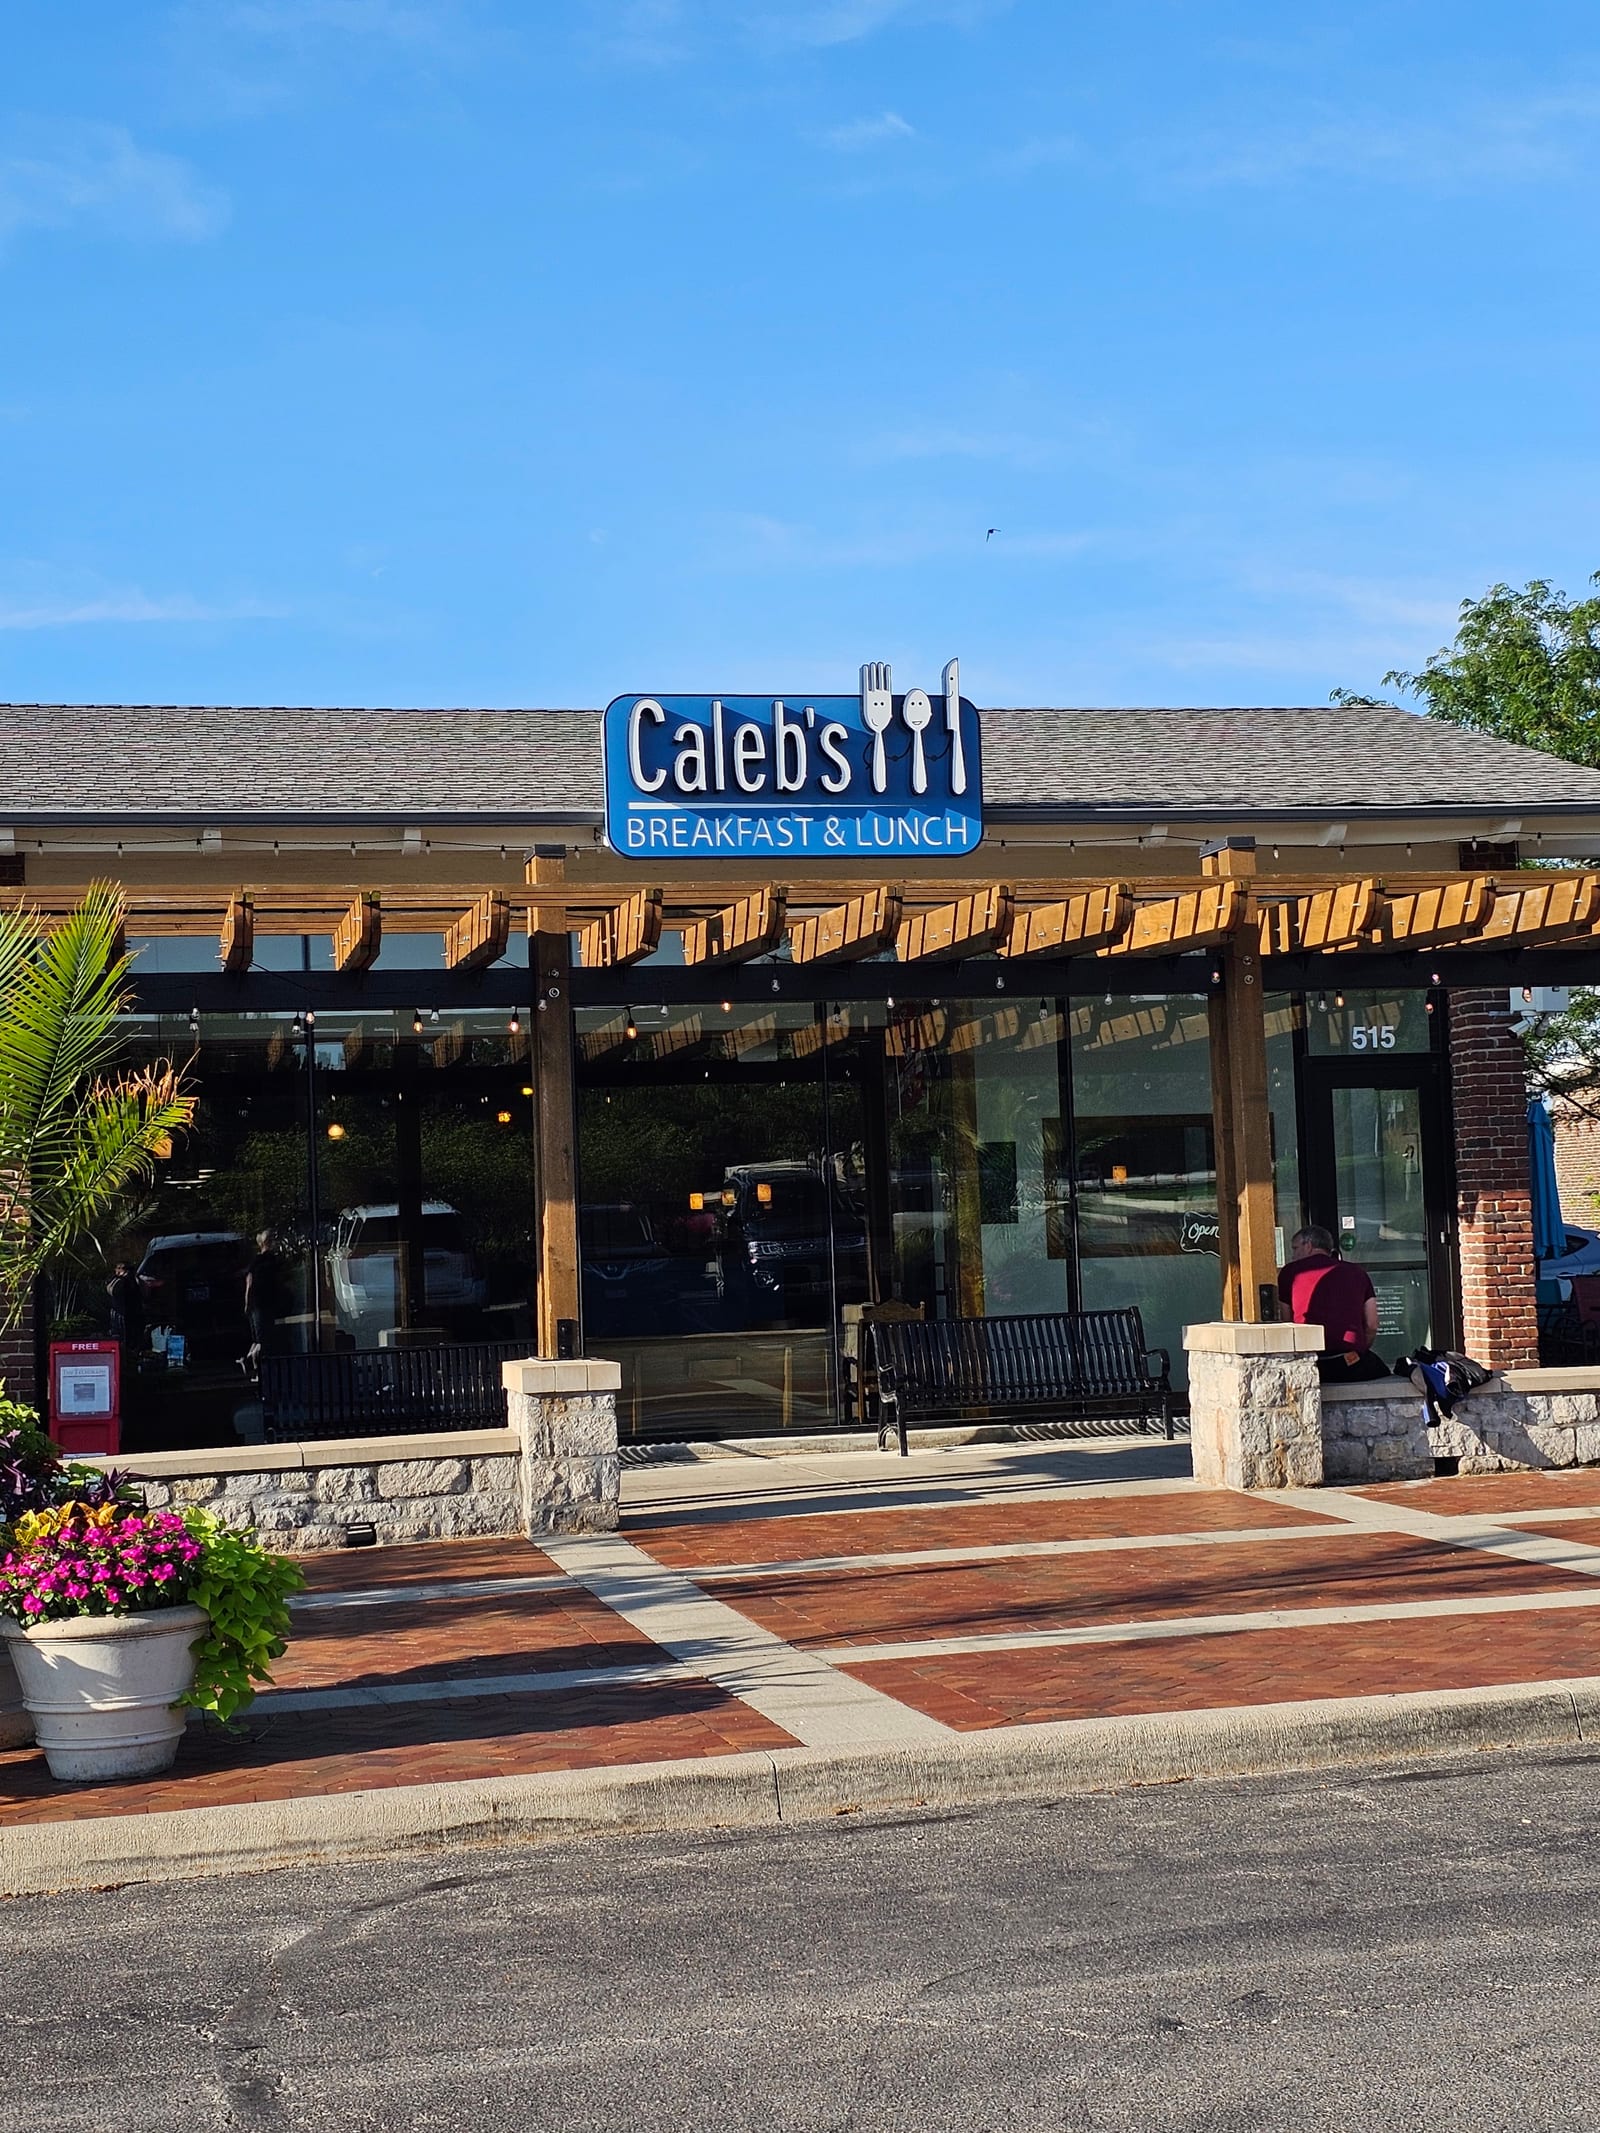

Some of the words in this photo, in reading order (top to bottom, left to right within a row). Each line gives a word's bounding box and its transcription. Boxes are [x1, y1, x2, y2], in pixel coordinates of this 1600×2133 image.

[628, 698, 851, 793] Caleb's
[627, 817, 814, 848] BREAKFAST
[824, 817, 847, 847] &
[856, 815, 967, 846] LUNCH
[1352, 1025, 1396, 1050] 515
[1188, 1222, 1220, 1244] Open
